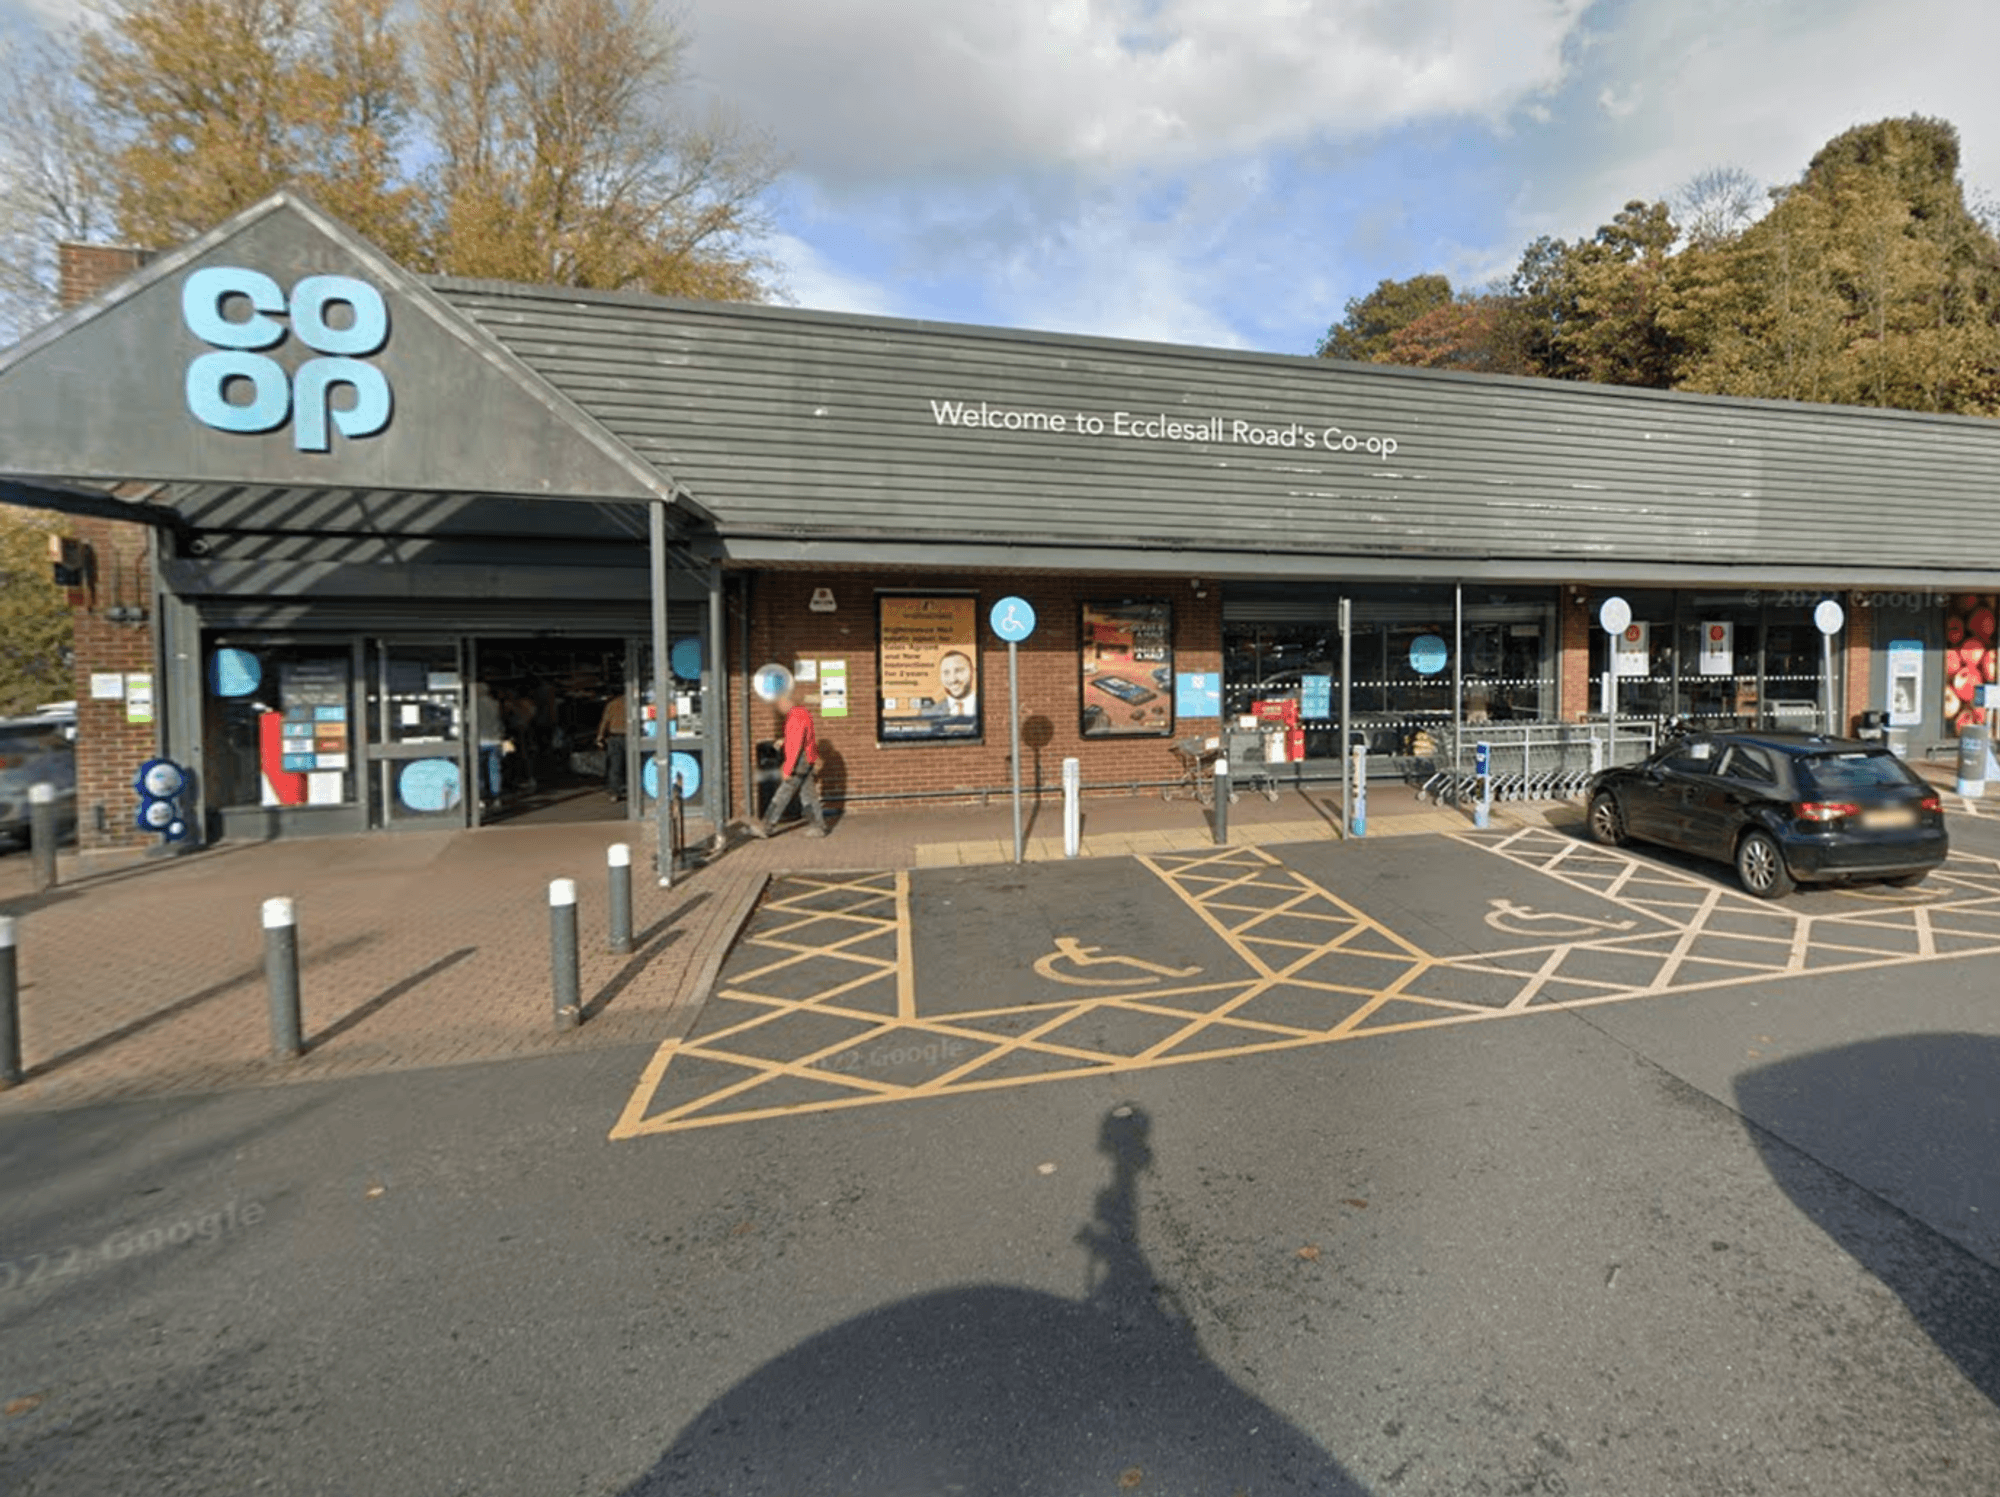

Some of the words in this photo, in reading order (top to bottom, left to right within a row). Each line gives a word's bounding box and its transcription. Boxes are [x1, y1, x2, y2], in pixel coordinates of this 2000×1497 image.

[930, 400, 1066, 431] Welcome
[1076, 411, 1104, 435] to
[1113, 412, 1223, 442] Ecclesall
[1232, 421, 1315, 448] Road's
[1323, 428, 1398, 461] Co-op
